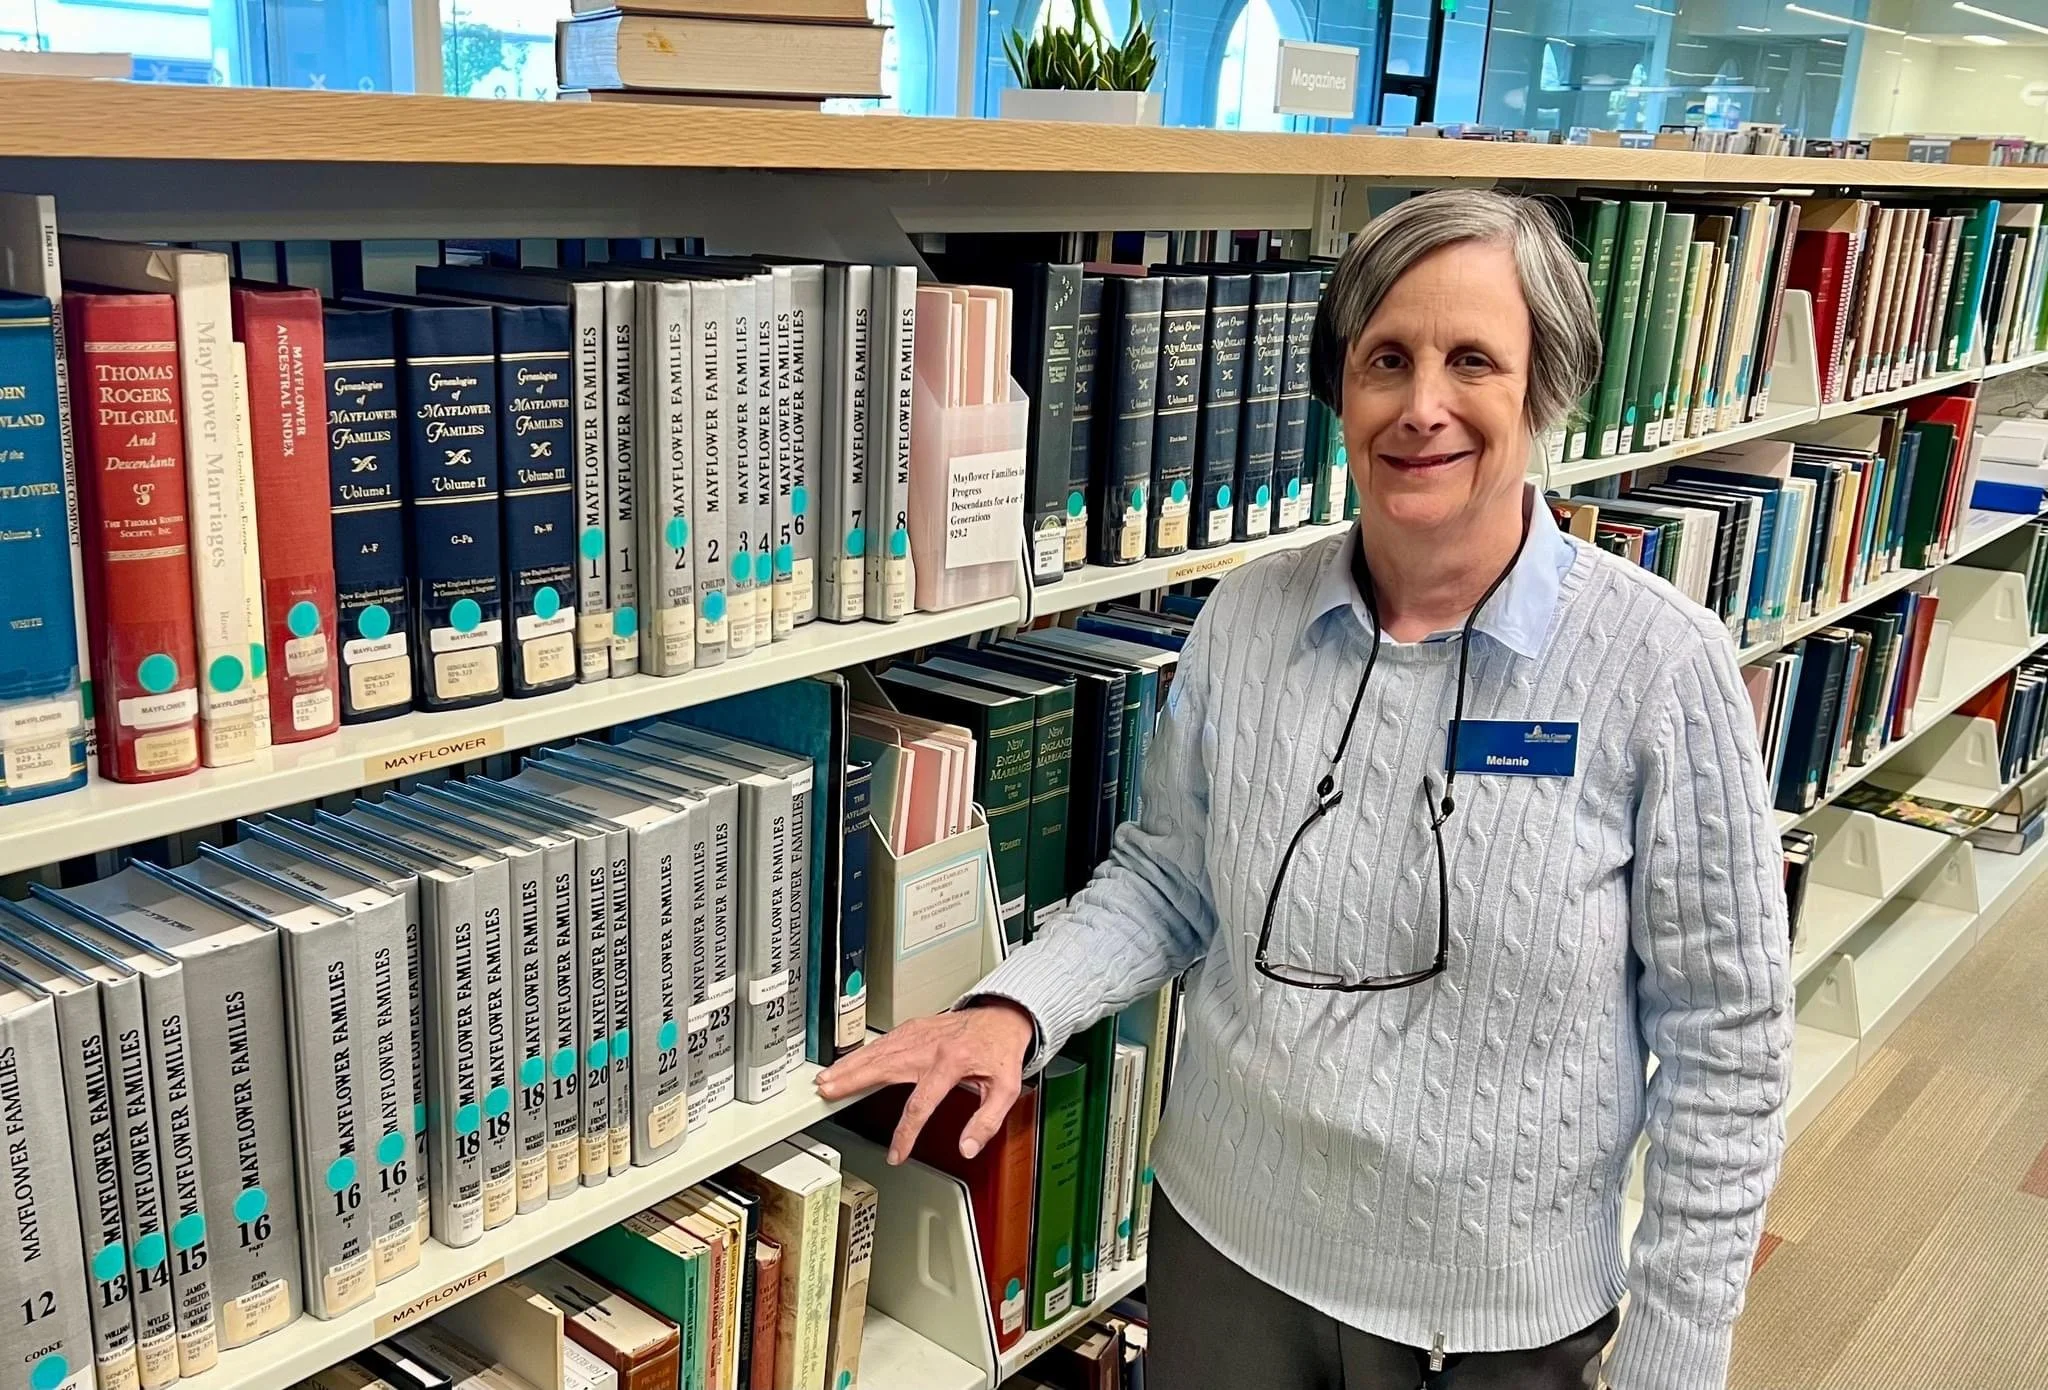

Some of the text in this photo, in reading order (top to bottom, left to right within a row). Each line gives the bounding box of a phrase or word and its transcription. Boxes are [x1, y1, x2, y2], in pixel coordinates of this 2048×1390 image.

[1291, 67, 1346, 91] Magazines
[52, 303, 65, 361] SIGNERS
[57, 363, 67, 381] OF
[96, 365, 173, 382] THOMAS
[195, 321, 219, 443] Mayflower
[334, 377, 383, 396] Genealogies
[101, 386, 173, 405] ROGERS,
[276, 324, 296, 457] ANCESTRAL INDEX
[292, 346, 307, 436] MAYFLOWER
[778, 312, 790, 496] MAYFLOWER FAMILIES
[793, 309, 804, 487] MAYFLOWER FAMILIES
[853, 307, 868, 484] MAYFLOWER FAMILIES
[898, 307, 914, 484] MAYFLOWER FAMILIES
[99, 408, 178, 426] PILGRIM,
[327, 409, 398, 425] MAYFLOWER
[617, 324, 632, 521] MAYFLOWER FAMILIES
[669, 323, 684, 518] MAYFLOWER FAMILIES
[705, 320, 719, 512] MAYFLOWER FAMILIES
[735, 316, 748, 504] MAYFLOWER FAMILIES
[758, 320, 770, 505] MAYFLOWER FAMILIES
[126, 432, 156, 448] And
[332, 428, 392, 450] FAMILIES
[426, 421, 485, 444] FAMILIES
[516, 415, 564, 436] FAMILIES
[583, 326, 600, 526] MAYFLOWER FAMILIES
[105, 455, 176, 471] Descendants
[518, 468, 566, 483] Volume III
[953, 471, 990, 485] Mayflower
[991, 467, 1018, 480] Families
[340, 485, 385, 500] Volume
[432, 476, 486, 492] Volume II
[952, 487, 982, 498] Progress
[206, 453, 228, 569] Marriages
[952, 496, 1004, 512] Descendants for
[794, 514, 804, 535] 6
[852, 509, 862, 529] 7
[896, 510, 906, 530] 8
[950, 513, 991, 526] Generations
[361, 543, 379, 554] A-F
[739, 530, 748, 552] 3
[758, 532, 769, 552] 4
[780, 524, 791, 545] 5
[620, 547, 633, 573] 1
[707, 539, 719, 563] 2
[1175, 557, 1234, 577] NEW ENGLAND
[141, 700, 187, 714] MAYFLOWER
[1007, 739, 1025, 752] NEW
[1040, 737, 1072, 755] ENGLAND
[1047, 726, 1064, 739] NEW
[384, 737, 487, 770] MAYFLOWER
[995, 750, 1031, 767] ENGLAND
[1486, 755, 1529, 766] Melanie
[790, 793, 804, 961] MAYFLOWER FAMILIES
[714, 822, 728, 983] MAYFLOWER FAMILIES
[771, 815, 785, 974] MAYFLOWER FAMILIES
[693, 841, 705, 1005] MAYFLOWER FAMILIES
[613, 858, 628, 1030] MAYFLOWER FAMILIES
[661, 854, 674, 1023] MAYFLOWER FAMILIES
[556, 873, 572, 1049] MAYFLOWER FAMILIES
[591, 866, 606, 1041] MAYFLOWER FAMILIES
[523, 880, 540, 1059] MAYFLOWER FAMILIES
[788, 967, 801, 986] 24
[485, 907, 505, 1089] MAYFLOWER FAMILIES
[766, 996, 785, 1022] 23
[456, 922, 475, 1108] MAYFLOWER FAMILIES
[710, 1004, 730, 1031] 23
[375, 947, 399, 1136] MAYFLOWER FAMILIES
[688, 1028, 708, 1054] 23
[329, 960, 356, 1157] MAYFLOWER FAMILIES
[616, 1058, 630, 1073] 21
[658, 1047, 678, 1076] 22
[226, 991, 260, 1189] MAYFLOWER FAMILIES
[553, 1073, 577, 1100] 19
[588, 1066, 608, 1089] 20
[521, 1082, 544, 1111] 18
[162, 1014, 198, 1219] MAYFLOWER FAMILIES
[487, 1111, 510, 1140] 18
[82, 1034, 122, 1247] MAYFLOWER FAMILIES
[120, 1028, 158, 1238] MAYFLOWER FAMILIES
[456, 1130, 480, 1160] 18
[0, 1046, 42, 1263] MAYFLOWER FAMILIES
[378, 1160, 407, 1193] 16
[334, 1183, 361, 1217] 16
[237, 1213, 272, 1248] 16
[177, 1241, 208, 1277] 15
[100, 1274, 128, 1308] 13
[136, 1260, 169, 1294] 14
[185, 1281, 207, 1297] JAMES
[21, 1290, 57, 1326] 12
[393, 1270, 488, 1323] MAYFLOWER
[25, 1340, 64, 1363] COOKE
[1024, 1343, 1044, 1359] NEW
